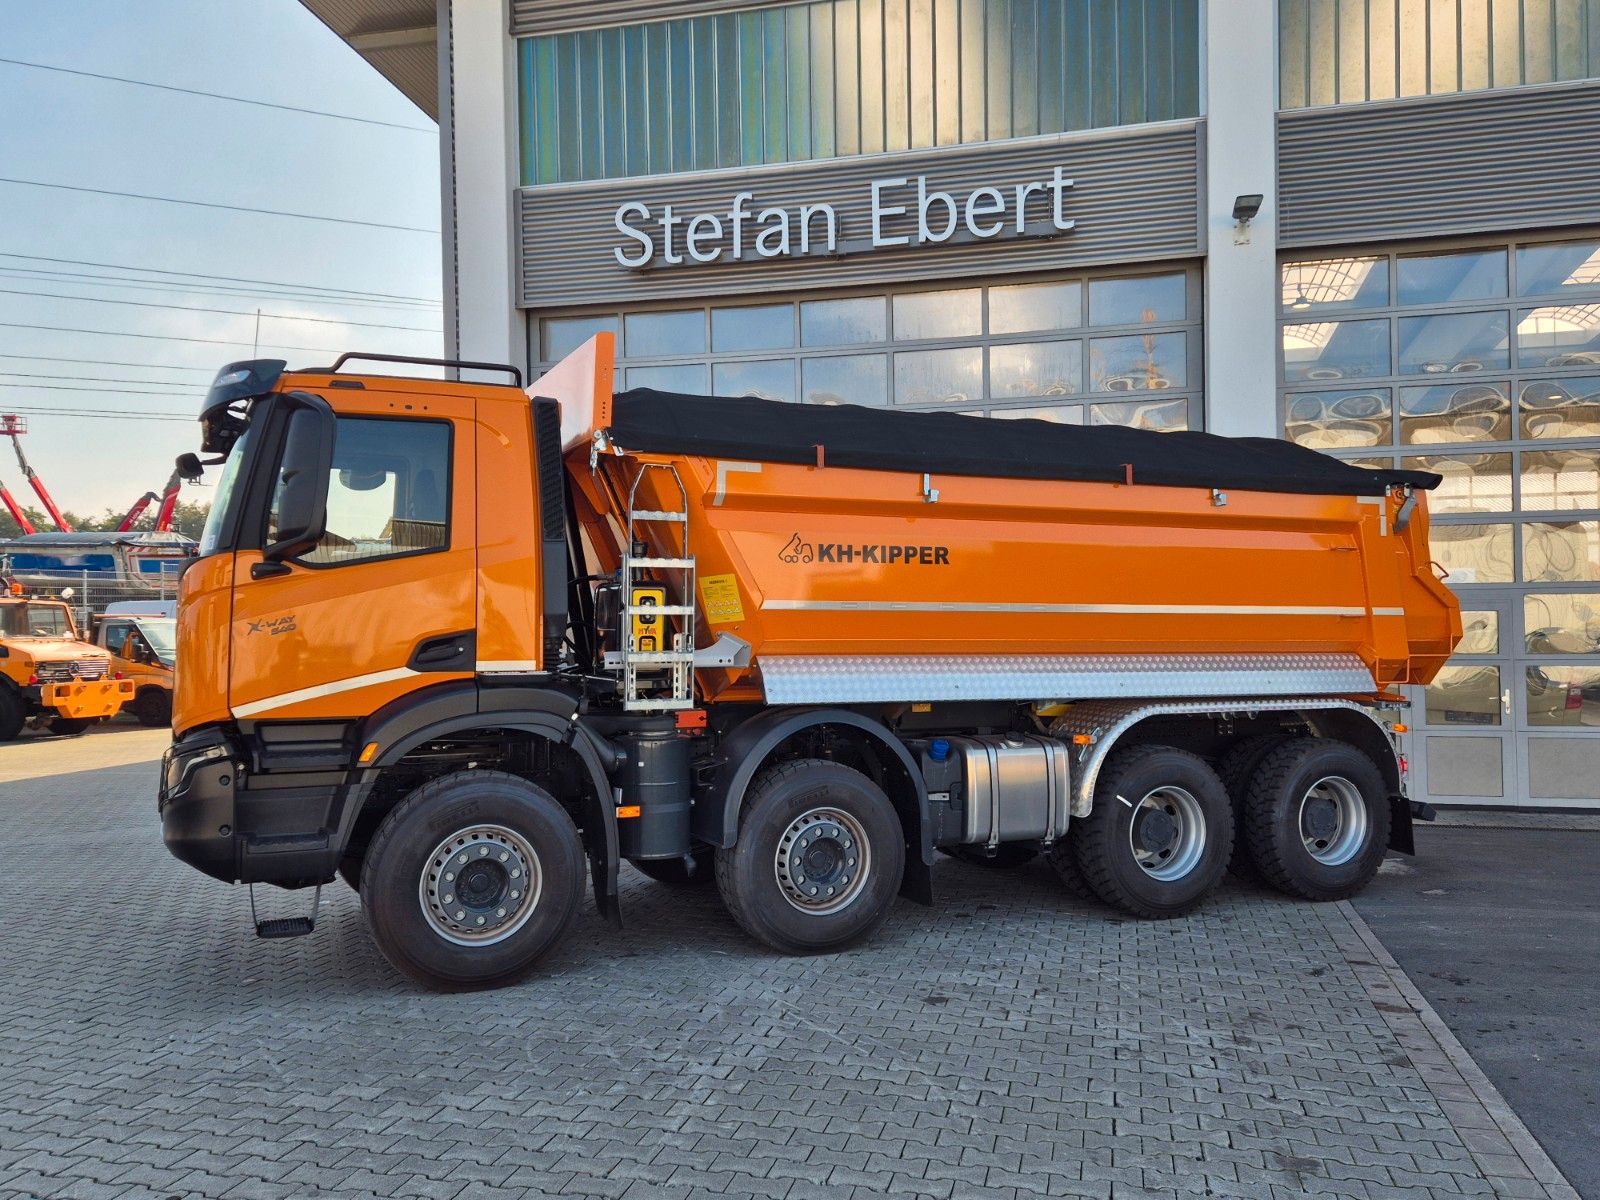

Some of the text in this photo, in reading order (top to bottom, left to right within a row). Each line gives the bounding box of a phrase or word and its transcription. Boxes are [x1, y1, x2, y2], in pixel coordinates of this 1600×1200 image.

[614, 166, 1075, 268] Stefan Ebert
[818, 543, 950, 565] KH-KIPPER
